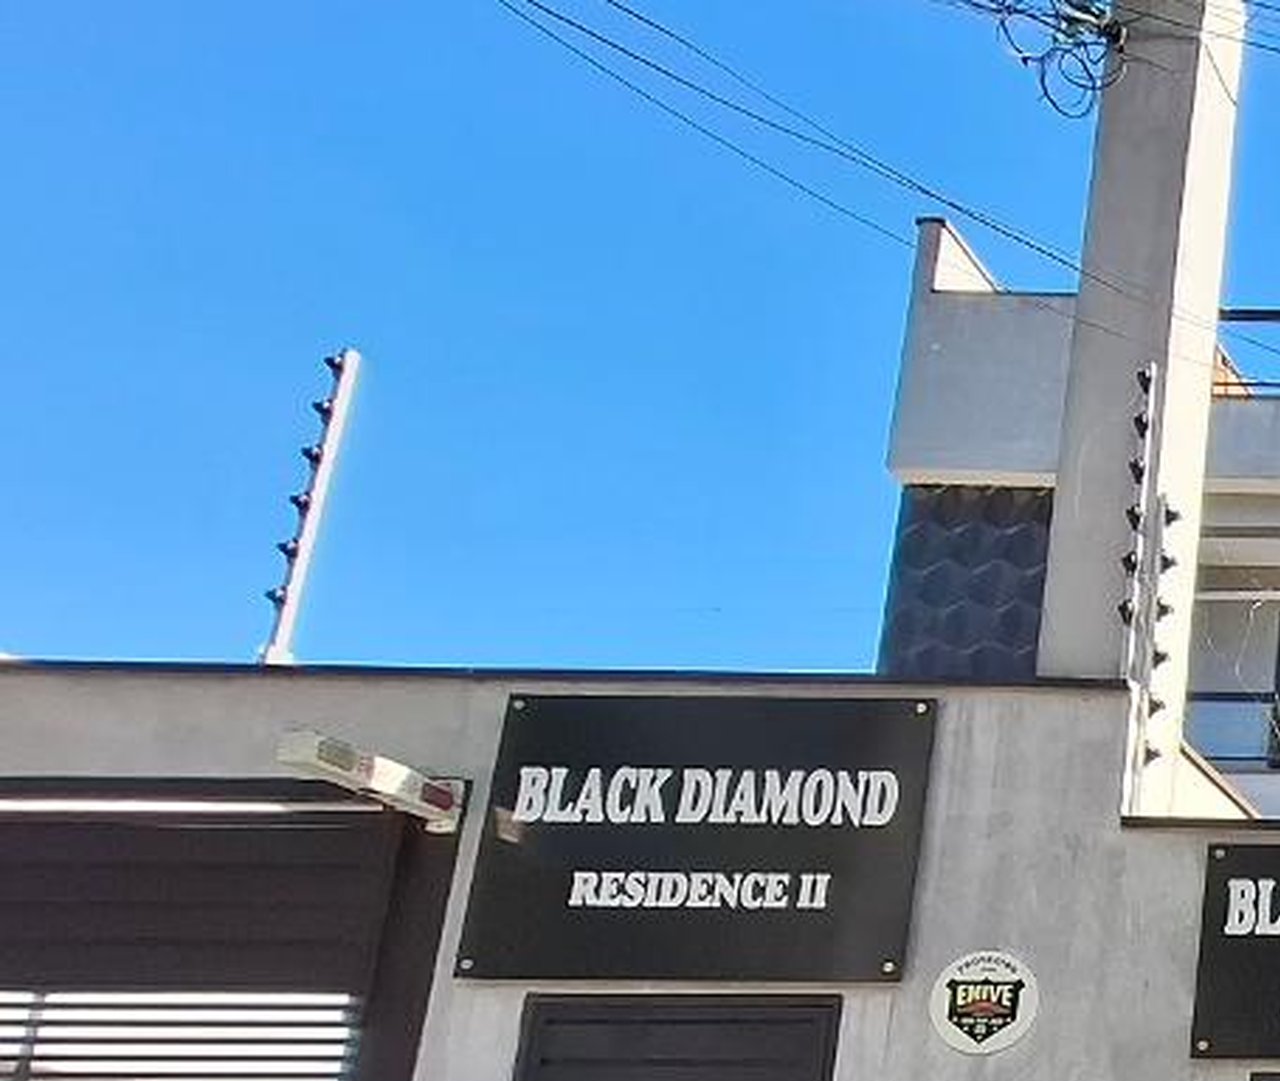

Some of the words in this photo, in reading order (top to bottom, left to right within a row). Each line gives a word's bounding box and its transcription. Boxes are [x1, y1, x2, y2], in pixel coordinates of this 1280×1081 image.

[512, 766, 673, 824] BLACK
[675, 769, 899, 828] DIAMOND
[568, 871, 790, 909] RESIDENCE
[796, 873, 831, 909] II
